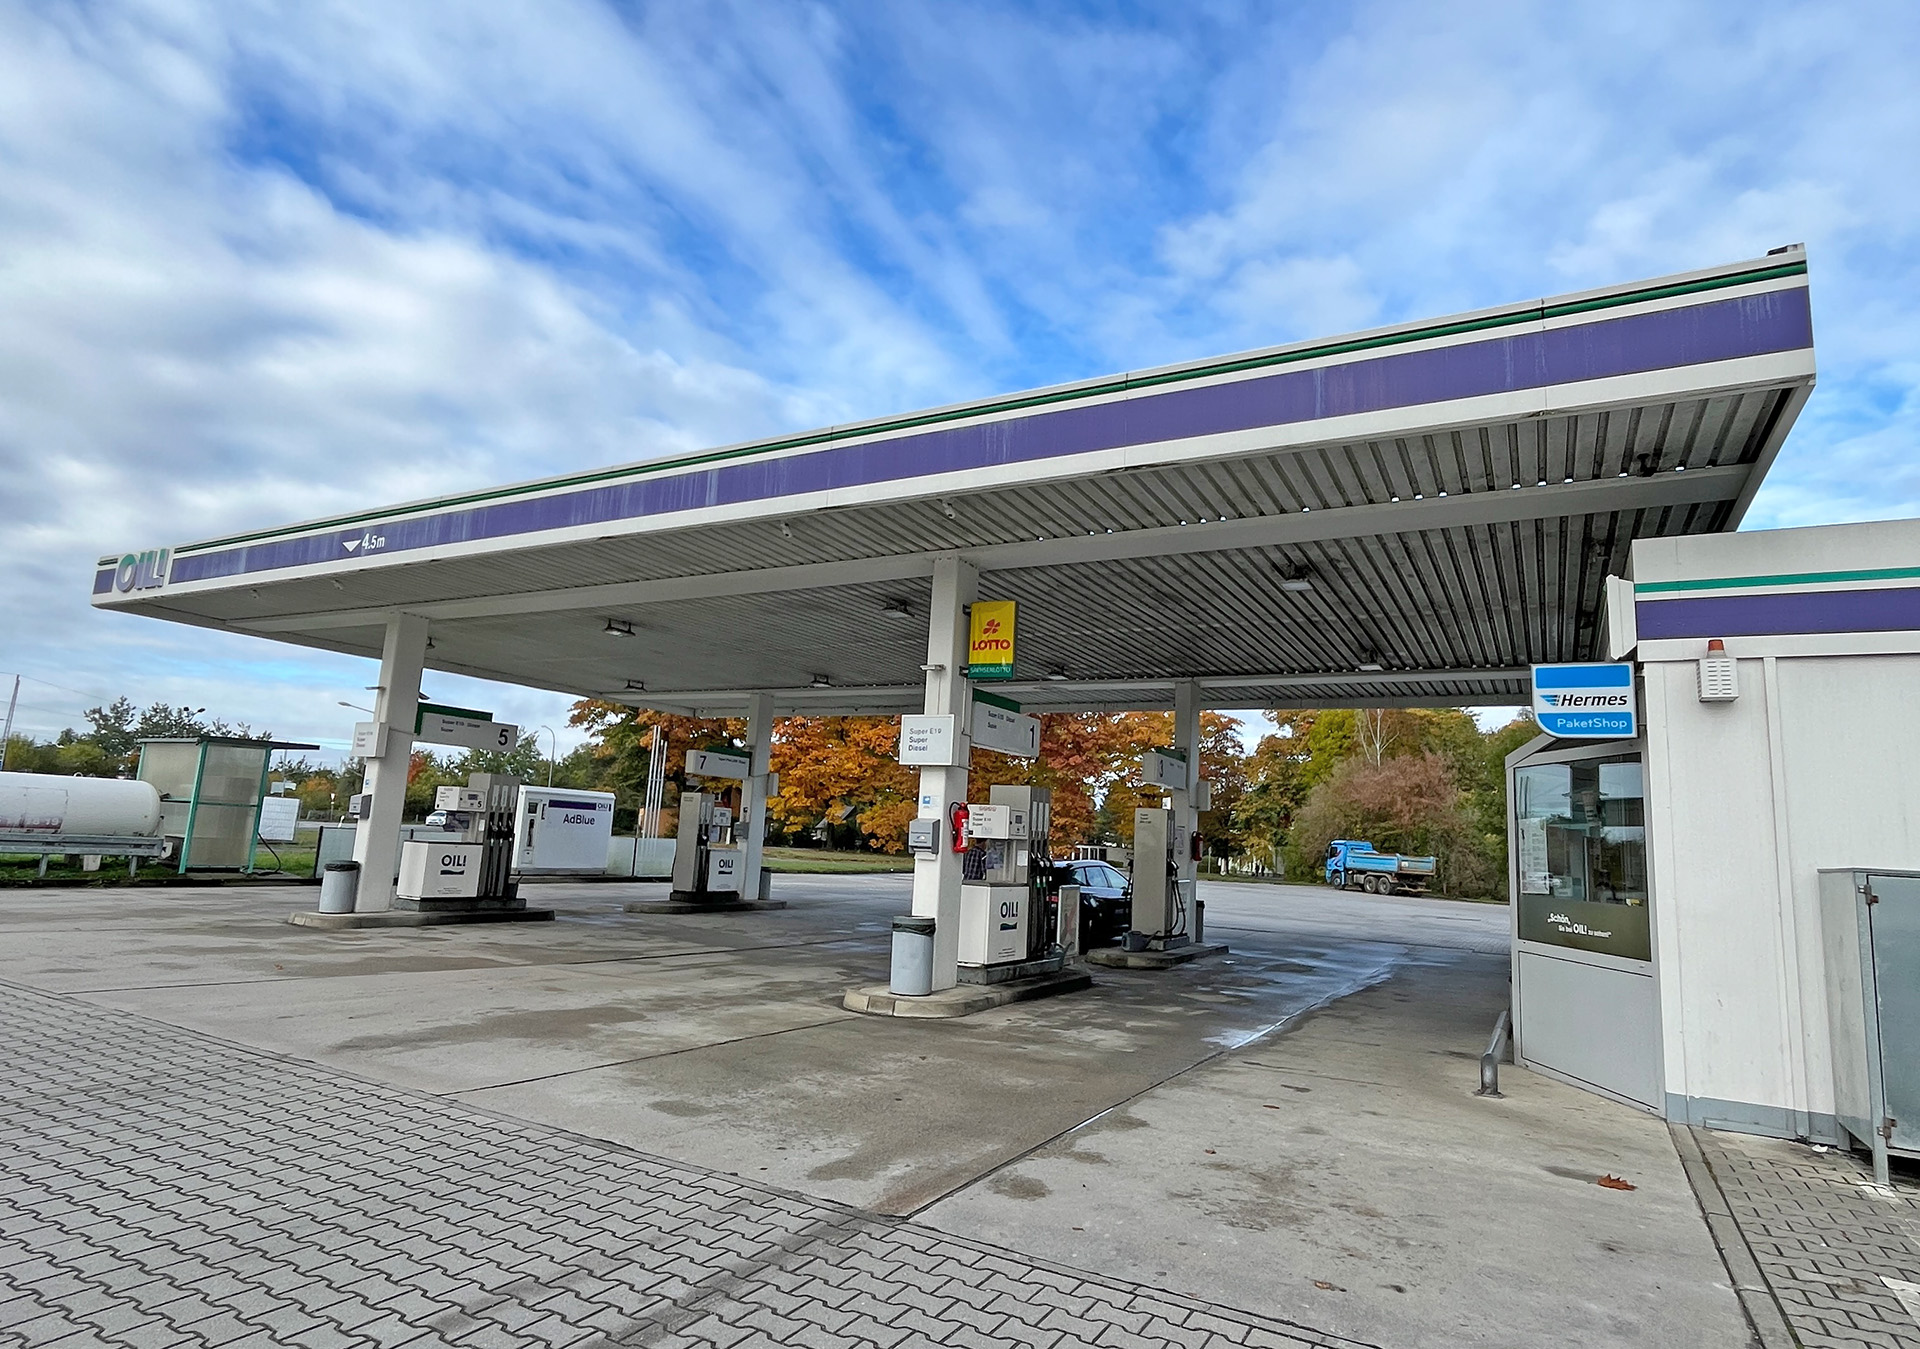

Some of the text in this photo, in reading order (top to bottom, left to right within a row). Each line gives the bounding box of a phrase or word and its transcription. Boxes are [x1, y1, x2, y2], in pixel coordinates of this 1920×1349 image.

[116, 548, 170, 593] OIL!
[972, 639, 1011, 651] LOTTO
[1561, 694, 1627, 707] Hermes
[1557, 718, 1627, 730] PaketShop
[909, 727, 929, 735] Super
[1030, 724, 1035, 749] 1
[497, 729, 509, 746] 5
[909, 736, 928, 744] Super
[908, 744, 928, 752] Diesel
[699, 755, 707, 770] 7
[563, 814, 596, 825] AdBlue
[441, 854, 467, 867] OIL!
[1000, 901, 1019, 918] OIL!
[1573, 923, 1587, 935] OIL!
